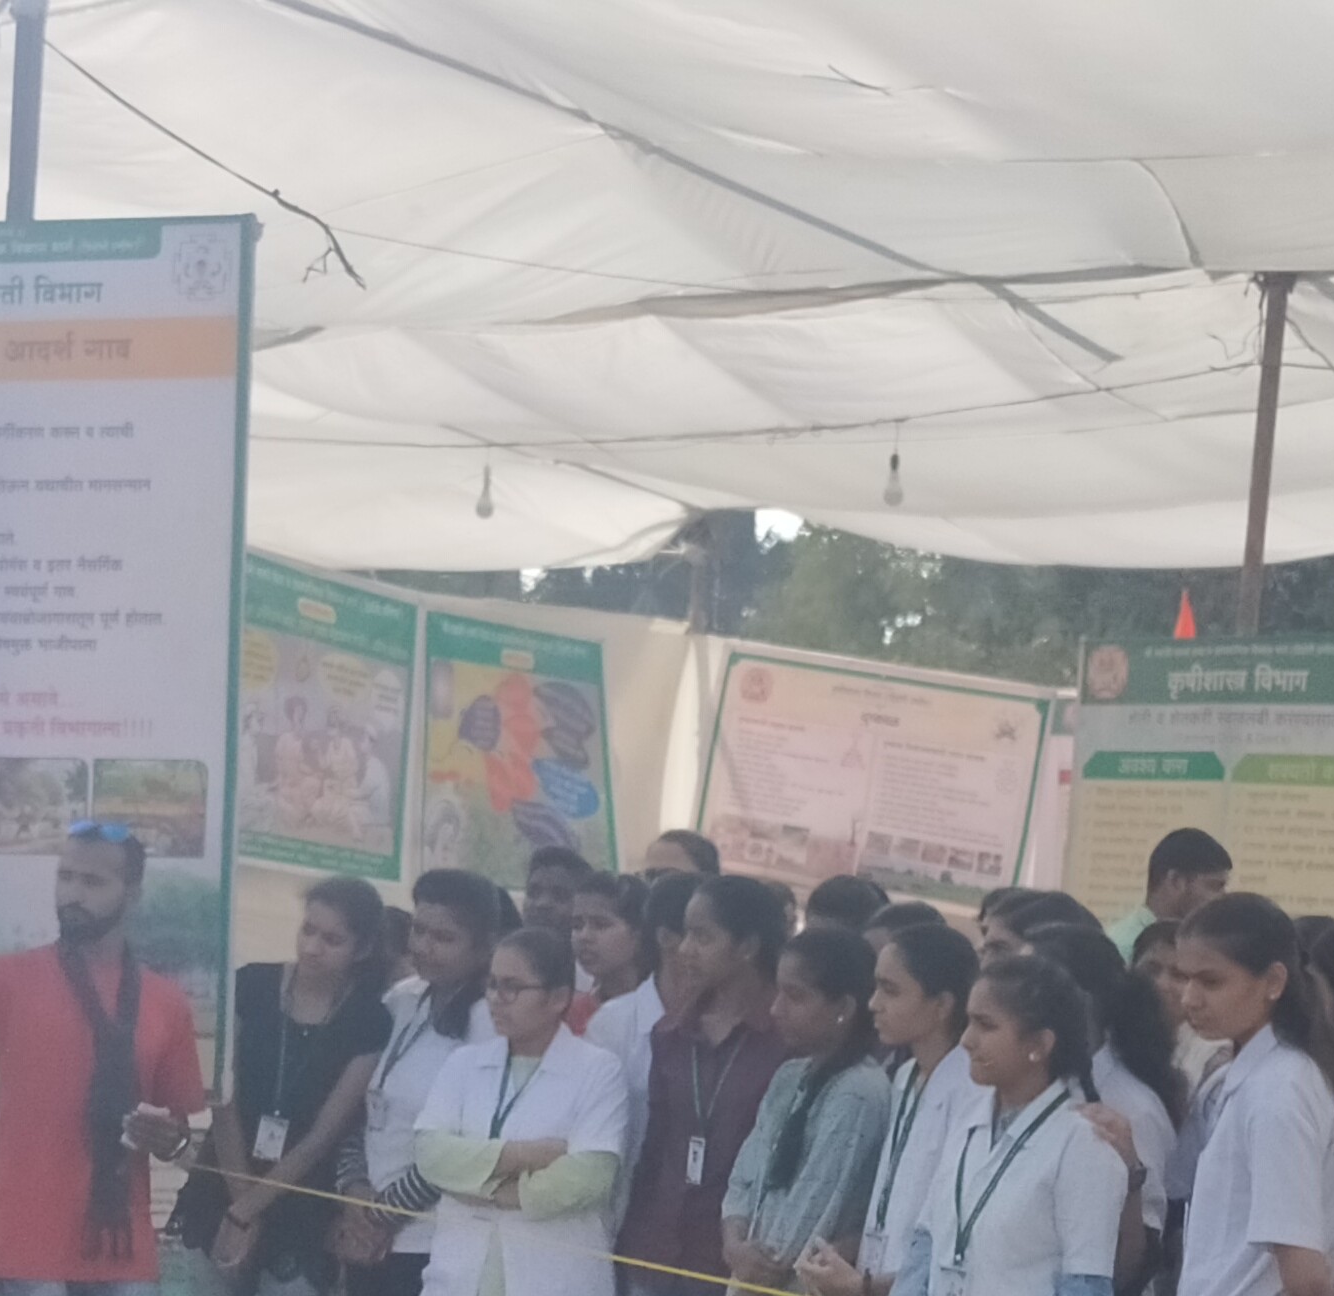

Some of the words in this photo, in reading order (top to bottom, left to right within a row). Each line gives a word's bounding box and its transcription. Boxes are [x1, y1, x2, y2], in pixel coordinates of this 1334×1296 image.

[34, 274, 104, 305] विभाग
[5, 332, 74, 363] आदर्श
[83, 338, 134, 362] गाव
[1254, 663, 1310, 693] विभाग
